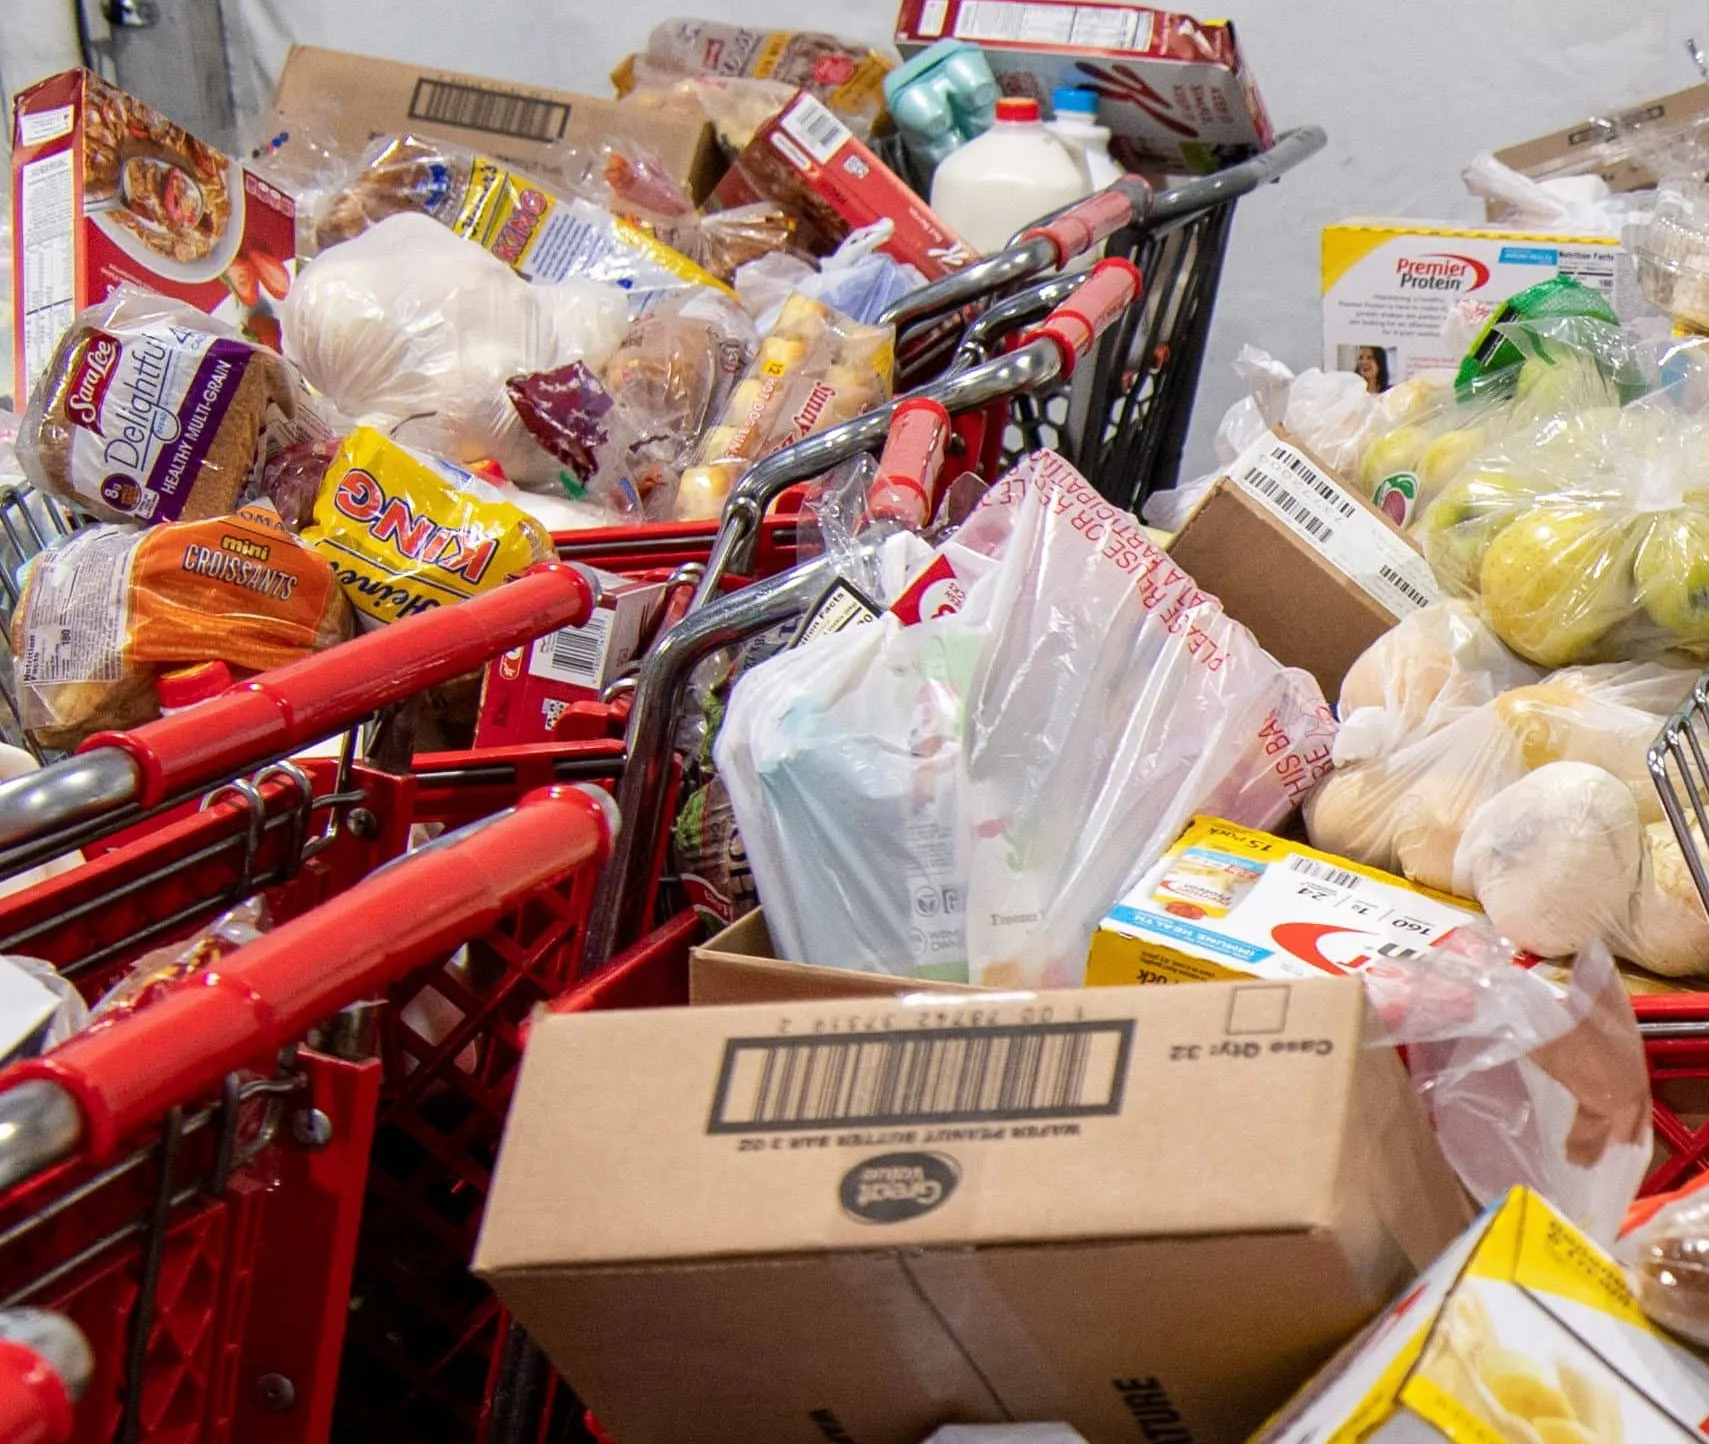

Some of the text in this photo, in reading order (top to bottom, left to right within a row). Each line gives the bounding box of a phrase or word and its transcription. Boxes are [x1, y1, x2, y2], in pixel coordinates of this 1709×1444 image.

[1396, 257, 1469, 279] Premier
[1400, 273, 1463, 292] Protein
[104, 333, 168, 472] Delightful
[161, 360, 232, 495] HEALTHY MULTI-GRAIN
[335, 468, 500, 585] KING
[1069, 506, 1105, 541] OR
[221, 535, 272, 561] mini
[182, 544, 298, 601] CROISSANTS
[1159, 607, 1232, 672] PLEASE
[1206, 827, 1274, 854] 15 Pack
[1392, 919, 1435, 937] 160
[1168, 1043, 1197, 1061] 32
[1202, 1038, 1262, 1062] Qty:
[853, 1177, 945, 1208] Great
